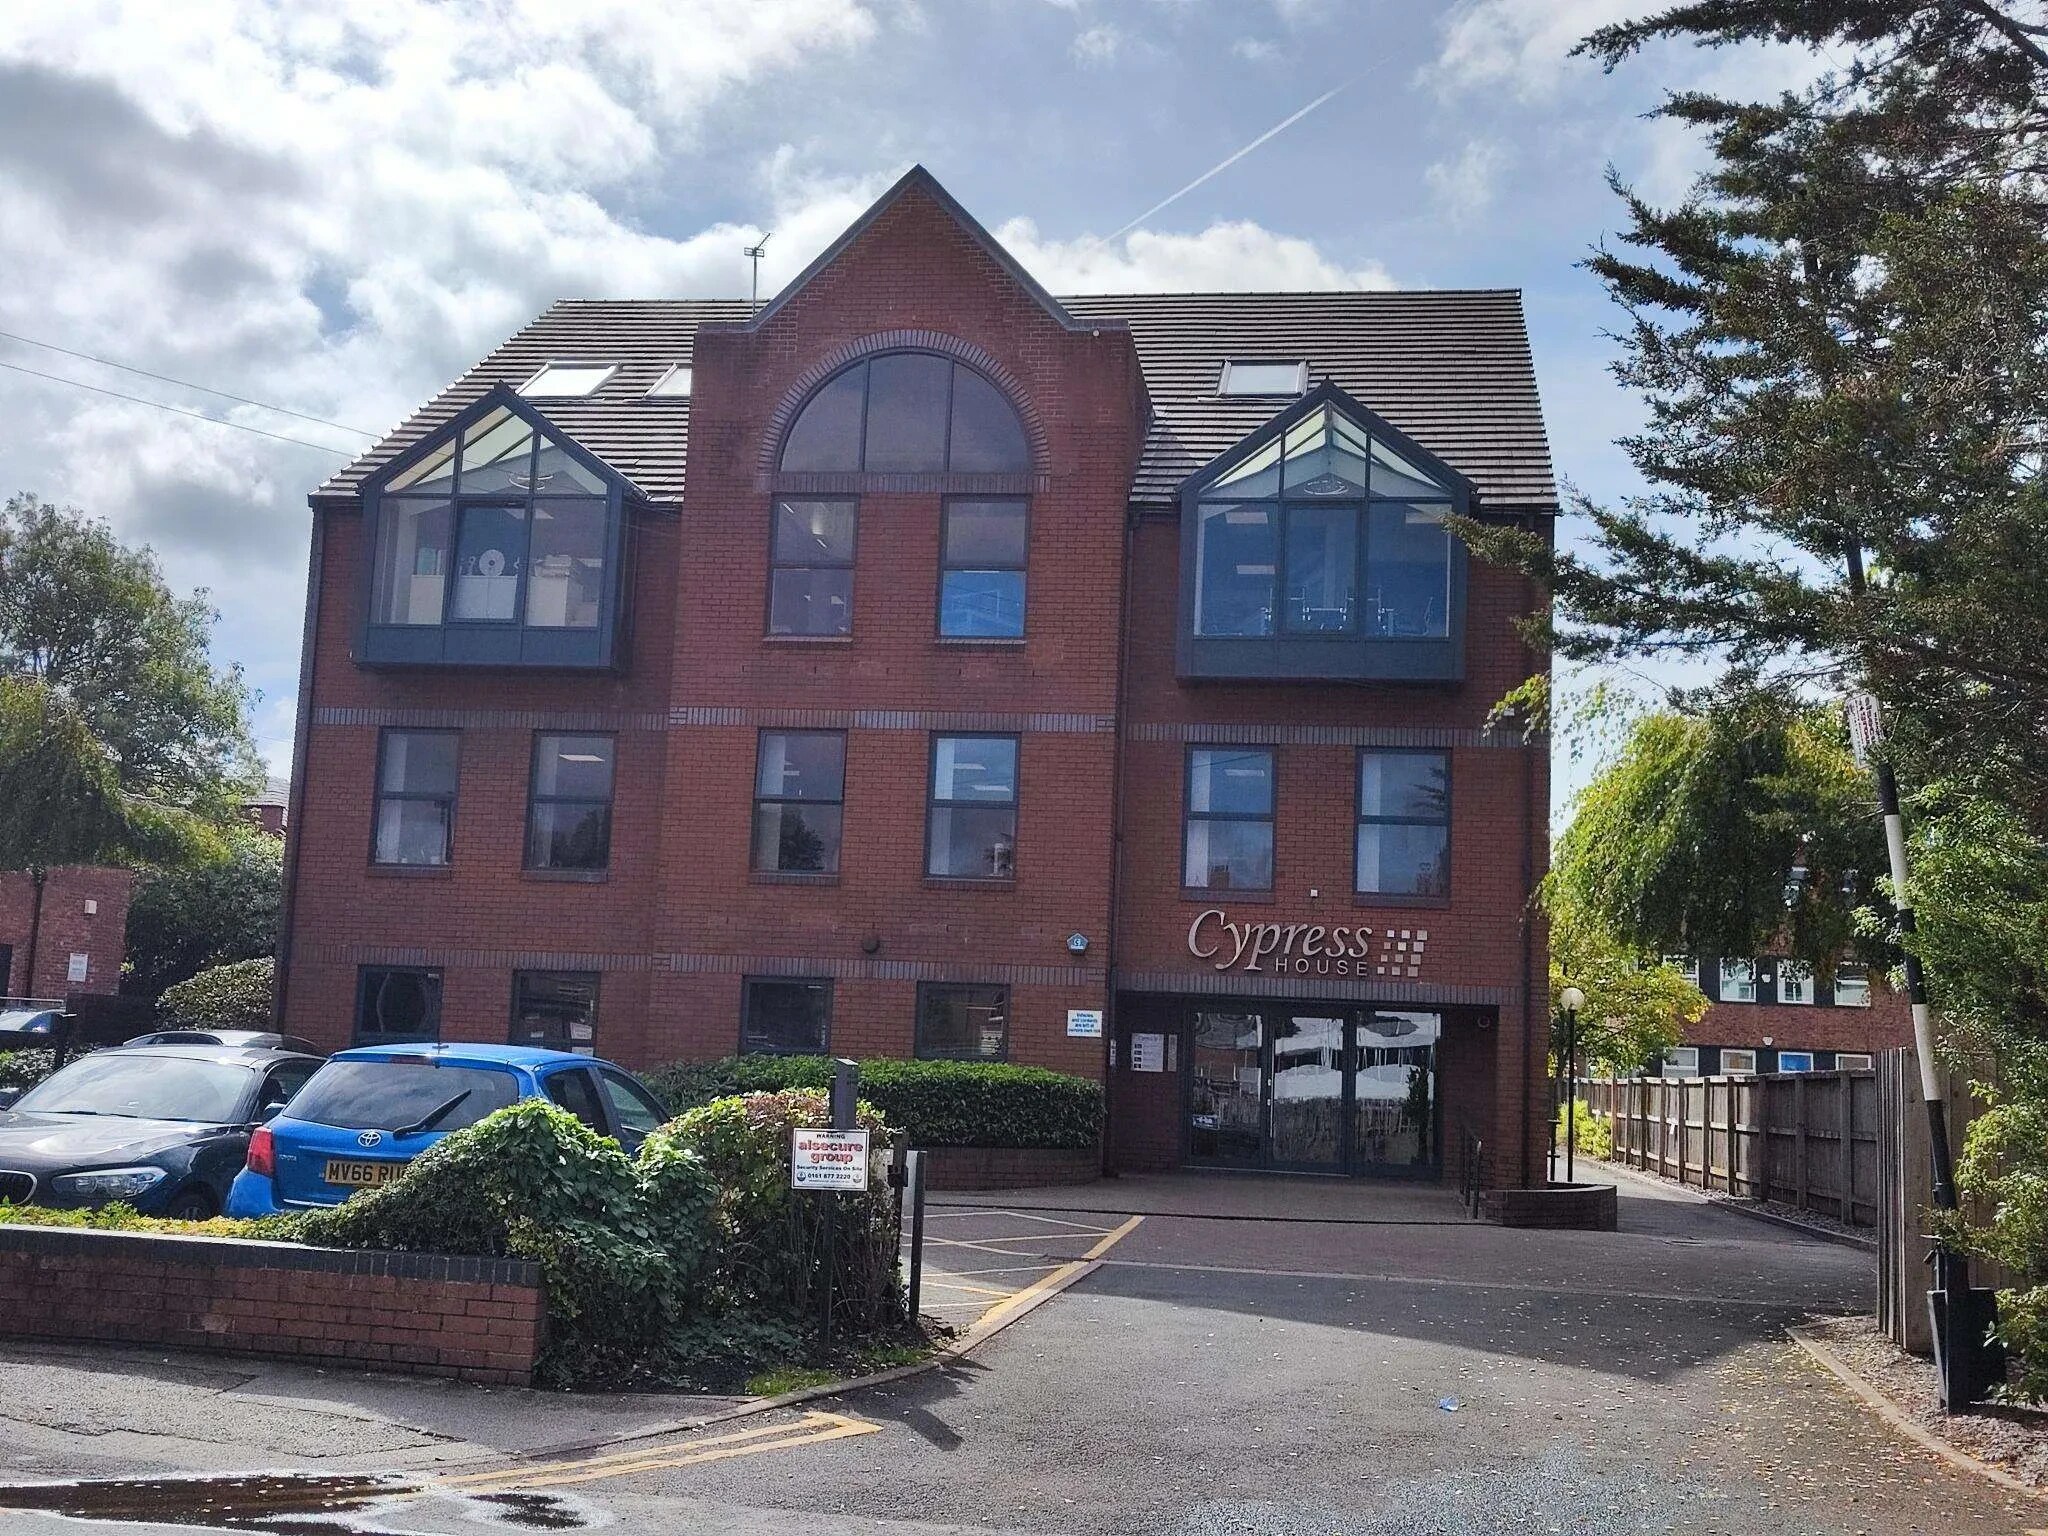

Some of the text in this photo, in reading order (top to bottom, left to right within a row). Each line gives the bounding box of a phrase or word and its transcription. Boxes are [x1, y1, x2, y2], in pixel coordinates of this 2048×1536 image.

[1188, 909, 1373, 970] Cypress
[1275, 958, 1369, 977] HOUSE
[798, 1140, 864, 1151] alsecure
[810, 1152, 853, 1164] group
[328, 1162, 373, 1181] MV66
